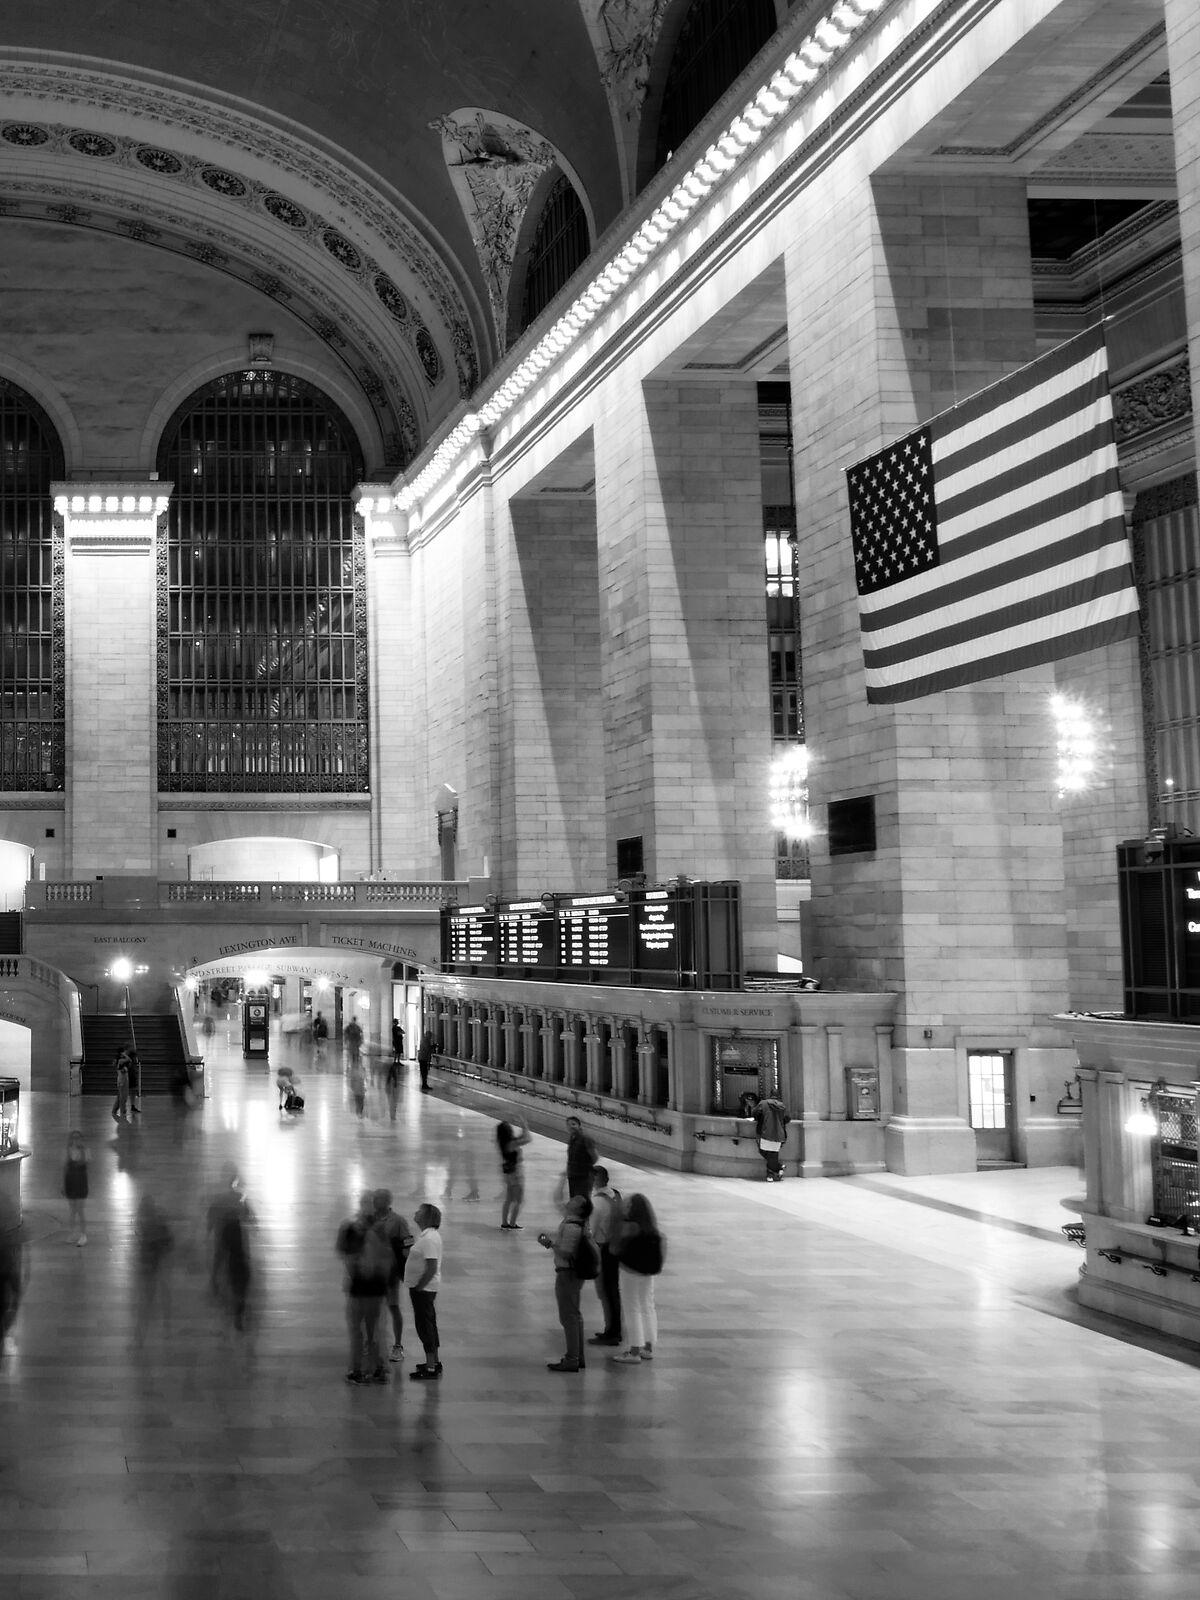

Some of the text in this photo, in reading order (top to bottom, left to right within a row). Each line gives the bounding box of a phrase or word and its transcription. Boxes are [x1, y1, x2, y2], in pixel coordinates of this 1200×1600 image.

[113, 936, 148, 944] BALCONY
[219, 935, 297, 956] LEXINGTON AVE
[332, 935, 418, 958] TICKET MACHINES
[206, 966, 235, 976] STREET
[276, 964, 311, 973] SUBWAY
[702, 1007, 774, 1017] CUSTOMER SERVICE
